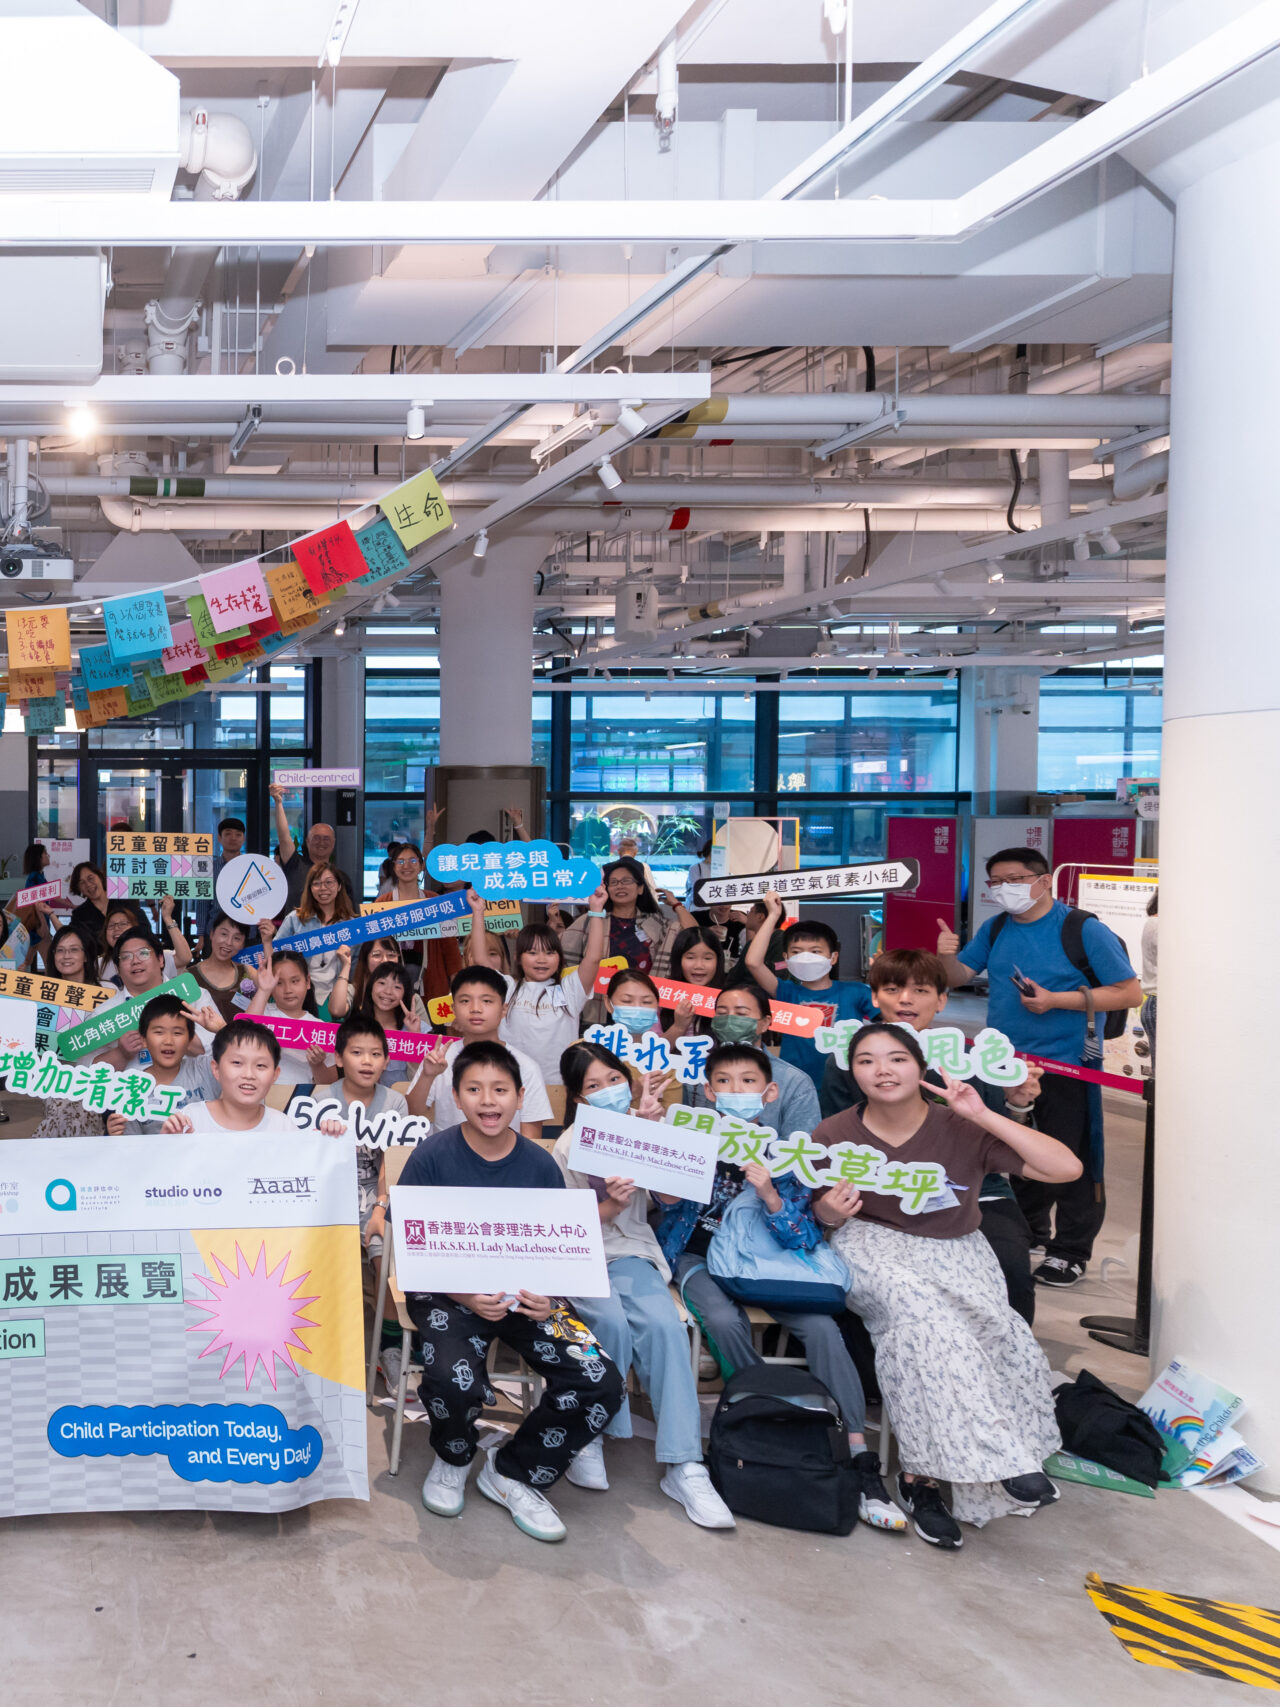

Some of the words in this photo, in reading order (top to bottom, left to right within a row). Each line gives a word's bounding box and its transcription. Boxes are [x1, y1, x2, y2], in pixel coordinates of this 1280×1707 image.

[393, 491, 444, 530] 生命
[278, 772, 355, 784] Child-centred
[110, 834, 211, 853] 兒童留聲台
[109, 856, 169, 875] 研討會
[196, 860, 209, 874] 暨
[437, 850, 550, 872] 讓兒童參與
[131, 879, 213, 898] 成果展覽
[483, 869, 589, 890] 成為日常！
[708, 868, 900, 899] 改善英皇道空氣質素小組
[20, 884, 58, 905] 兒童權利
[239, 897, 466, 966] 英皇到鼻敏感，還我舒服呼吸！
[441, 924, 457, 932] cum
[462, 919, 519, 932] Eibition
[68, 982, 190, 1052] 北角特色你！
[295, 1101, 341, 1130] 5G
[355, 1106, 426, 1147] Wifi
[597, 1130, 707, 1166] 香港聖公會麥理浩夫人中心
[595, 1143, 630, 1159] H.K.S.K.H.
[630, 1151, 646, 1162] Lady
[647, 1155, 682, 1170] MacLehose
[683, 1165, 705, 1176] Centre
[145, 1185, 189, 1198] studio
[193, 1187, 223, 1198] uno
[252, 1177, 311, 1194] AaaM
[427, 1221, 587, 1239] 香港聖公會麥理浩夫人中心
[429, 1241, 480, 1252] H.K.S.K.H.
[482, 1242, 503, 1255] Lady
[505, 1243, 557, 1254] MacLehose
[559, 1244, 591, 1254] Centre
[2, 1259, 179, 1303] 成果展覽
[60, 1420, 105, 1440] Child
[108, 1420, 220, 1441] Participation
[223, 1420, 282, 1443] Today,
[1197, 1432, 1212, 1447] the
[1208, 1396, 1243, 1433] Children
[187, 1447, 222, 1465] and
[226, 1447, 281, 1471] Every
[283, 1441, 313, 1466] Day!
